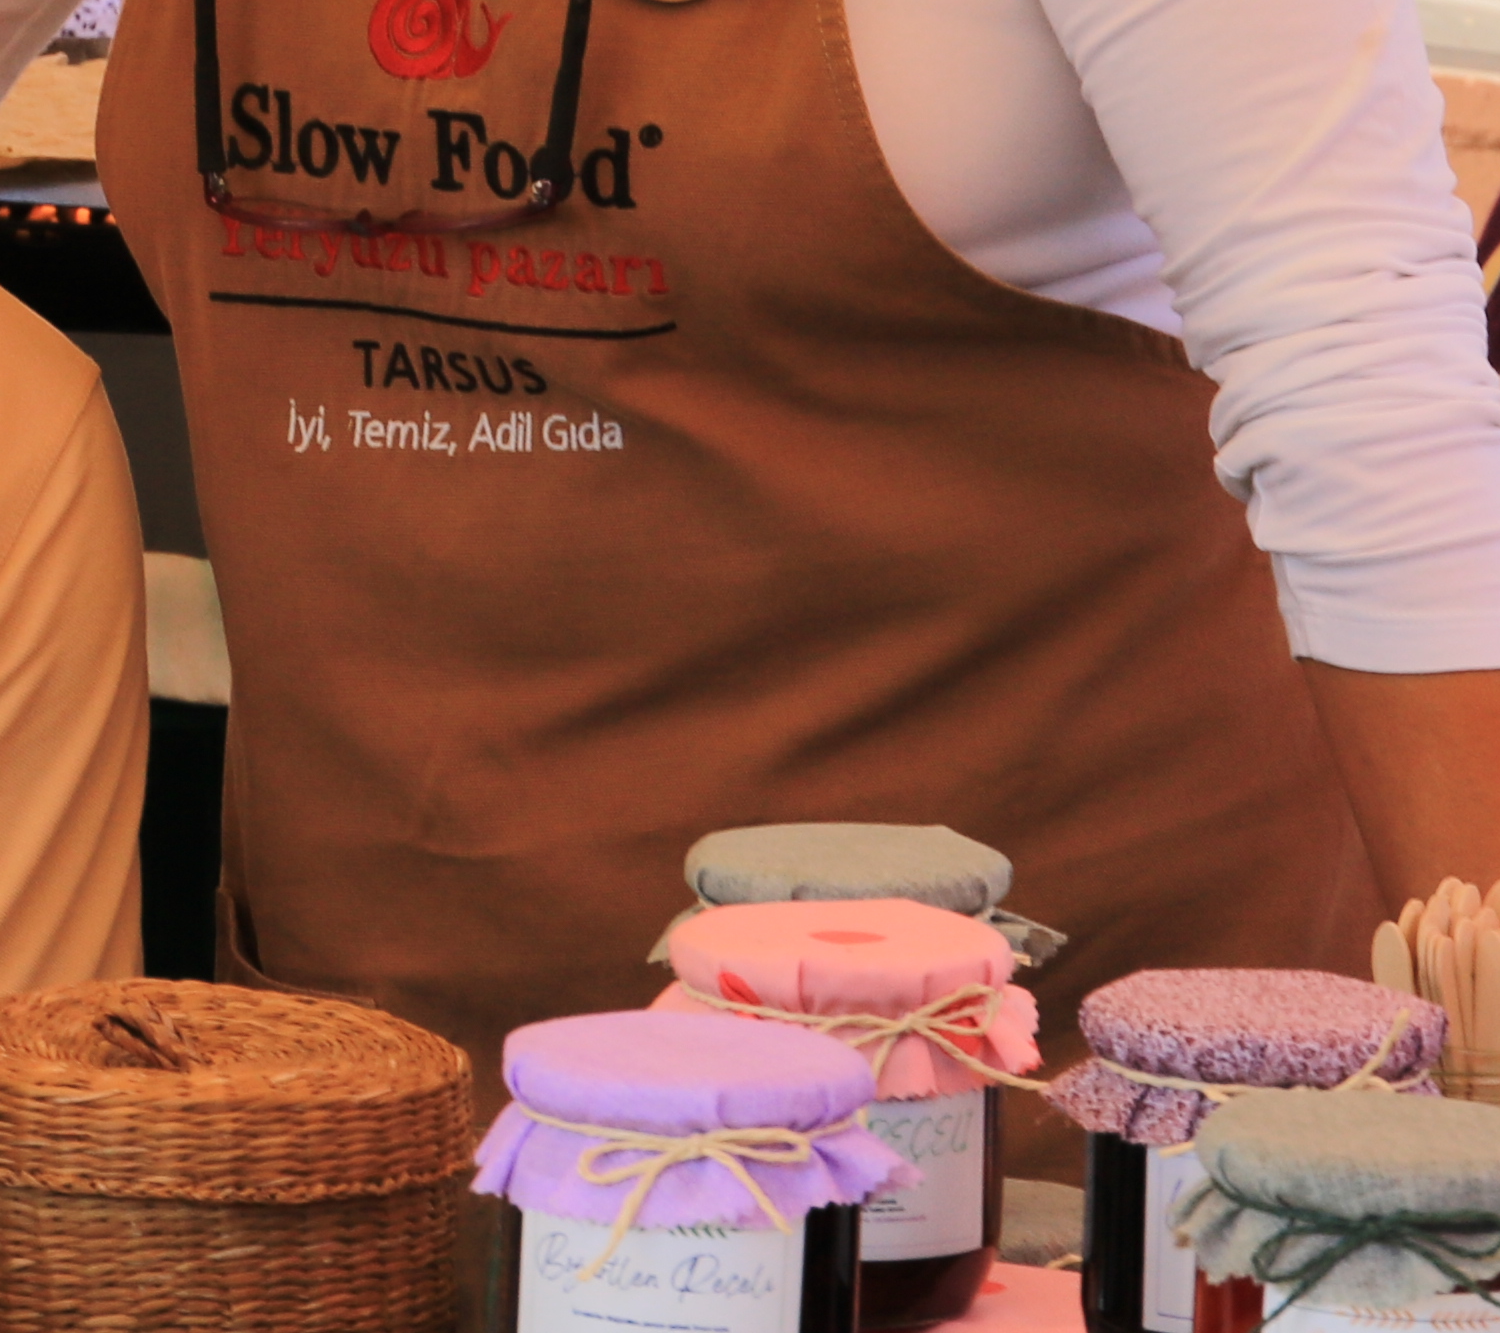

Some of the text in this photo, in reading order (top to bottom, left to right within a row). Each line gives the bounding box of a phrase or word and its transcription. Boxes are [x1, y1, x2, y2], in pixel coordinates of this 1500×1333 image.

[227, 82, 637, 209] Slow Fod
[352, 339, 548, 395] TARSUS
[467, 409, 533, 453] Adil
